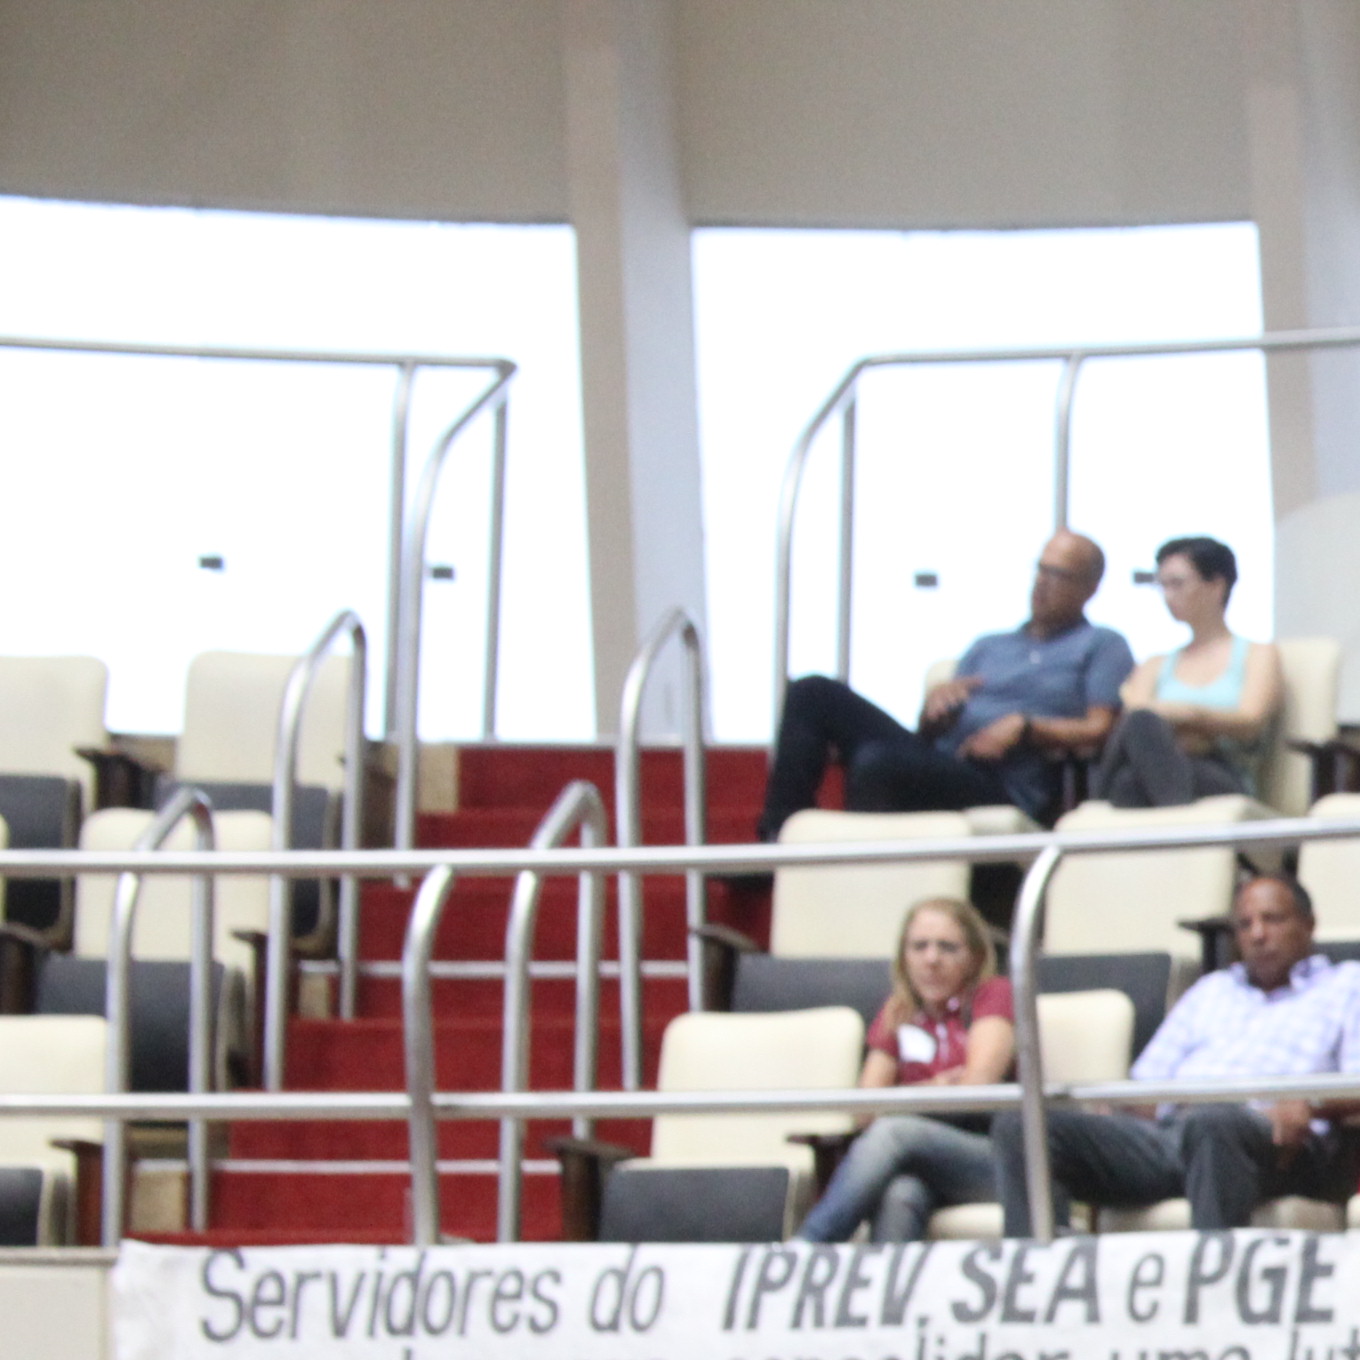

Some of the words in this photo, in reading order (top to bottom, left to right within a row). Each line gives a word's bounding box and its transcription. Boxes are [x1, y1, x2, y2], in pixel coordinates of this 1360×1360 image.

[200, 1247, 562, 1342] Servidores
[588, 1245, 665, 1331] do
[951, 1240, 1101, 1325] SEA
[1128, 1253, 1165, 1322] e
[1183, 1232, 1336, 1325] PGE
